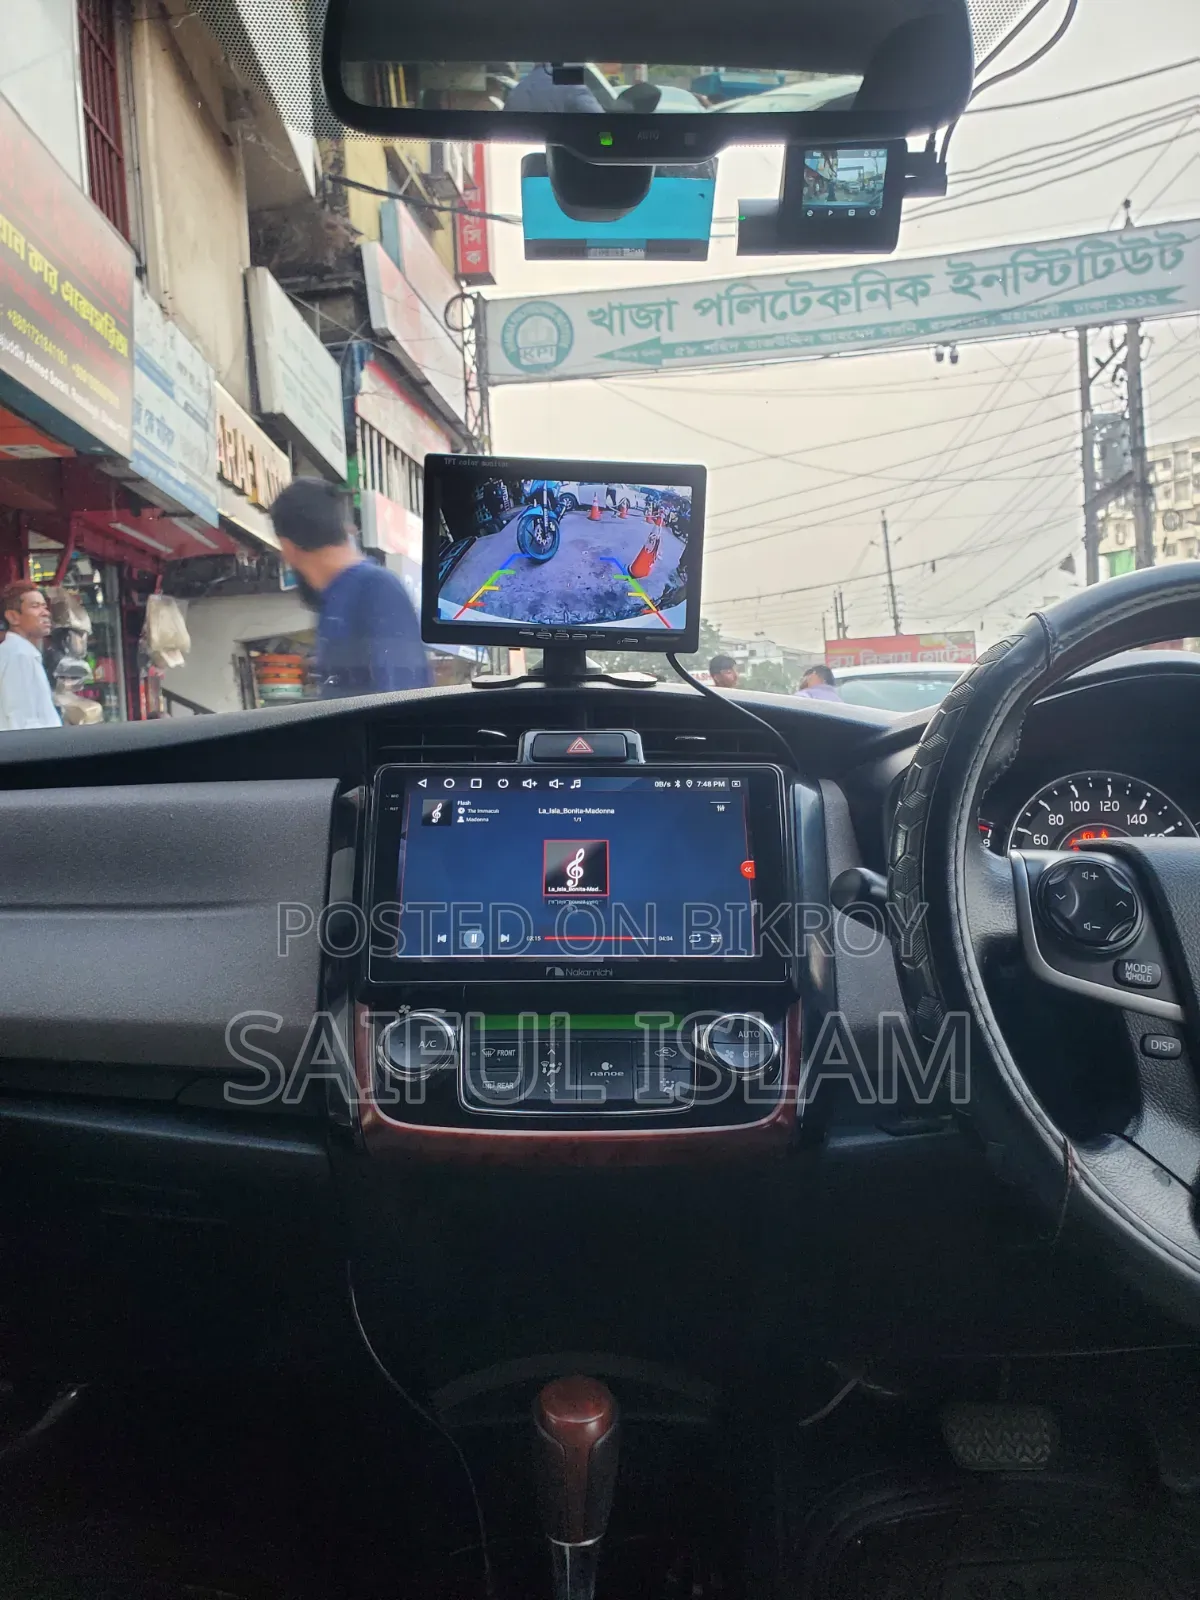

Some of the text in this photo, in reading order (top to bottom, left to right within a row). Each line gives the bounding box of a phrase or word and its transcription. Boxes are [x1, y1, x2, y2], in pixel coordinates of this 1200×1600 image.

[586, 297, 679, 336] খাজা
[693, 268, 935, 326] পলিটেকনিক
[945, 230, 1192, 301] ইনস্টিটিউট
[523, 346, 555, 360] KPI
[458, 458, 479, 467] color
[696, 780, 726, 788] 7:48 PM
[538, 807, 615, 815] La_Isla_Bonita-Madonna
[1069, 800, 1090, 813] 100
[1099, 800, 1120, 812] 120
[1048, 814, 1064, 826] 80
[1127, 813, 1148, 826] 140
[1033, 833, 1049, 846] 60
[566, 968, 613, 977] Nakamichi
[1124, 961, 1153, 975] MODE
[1131, 972, 1153, 983] HOLD
[737, 1030, 761, 1038] AUTO
[418, 1039, 437, 1049] A/C
[1150, 1039, 1175, 1052] DISP
[496, 1049, 516, 1057] FRONT
[742, 1050, 760, 1058] OFF
[496, 1081, 514, 1089] REAR
